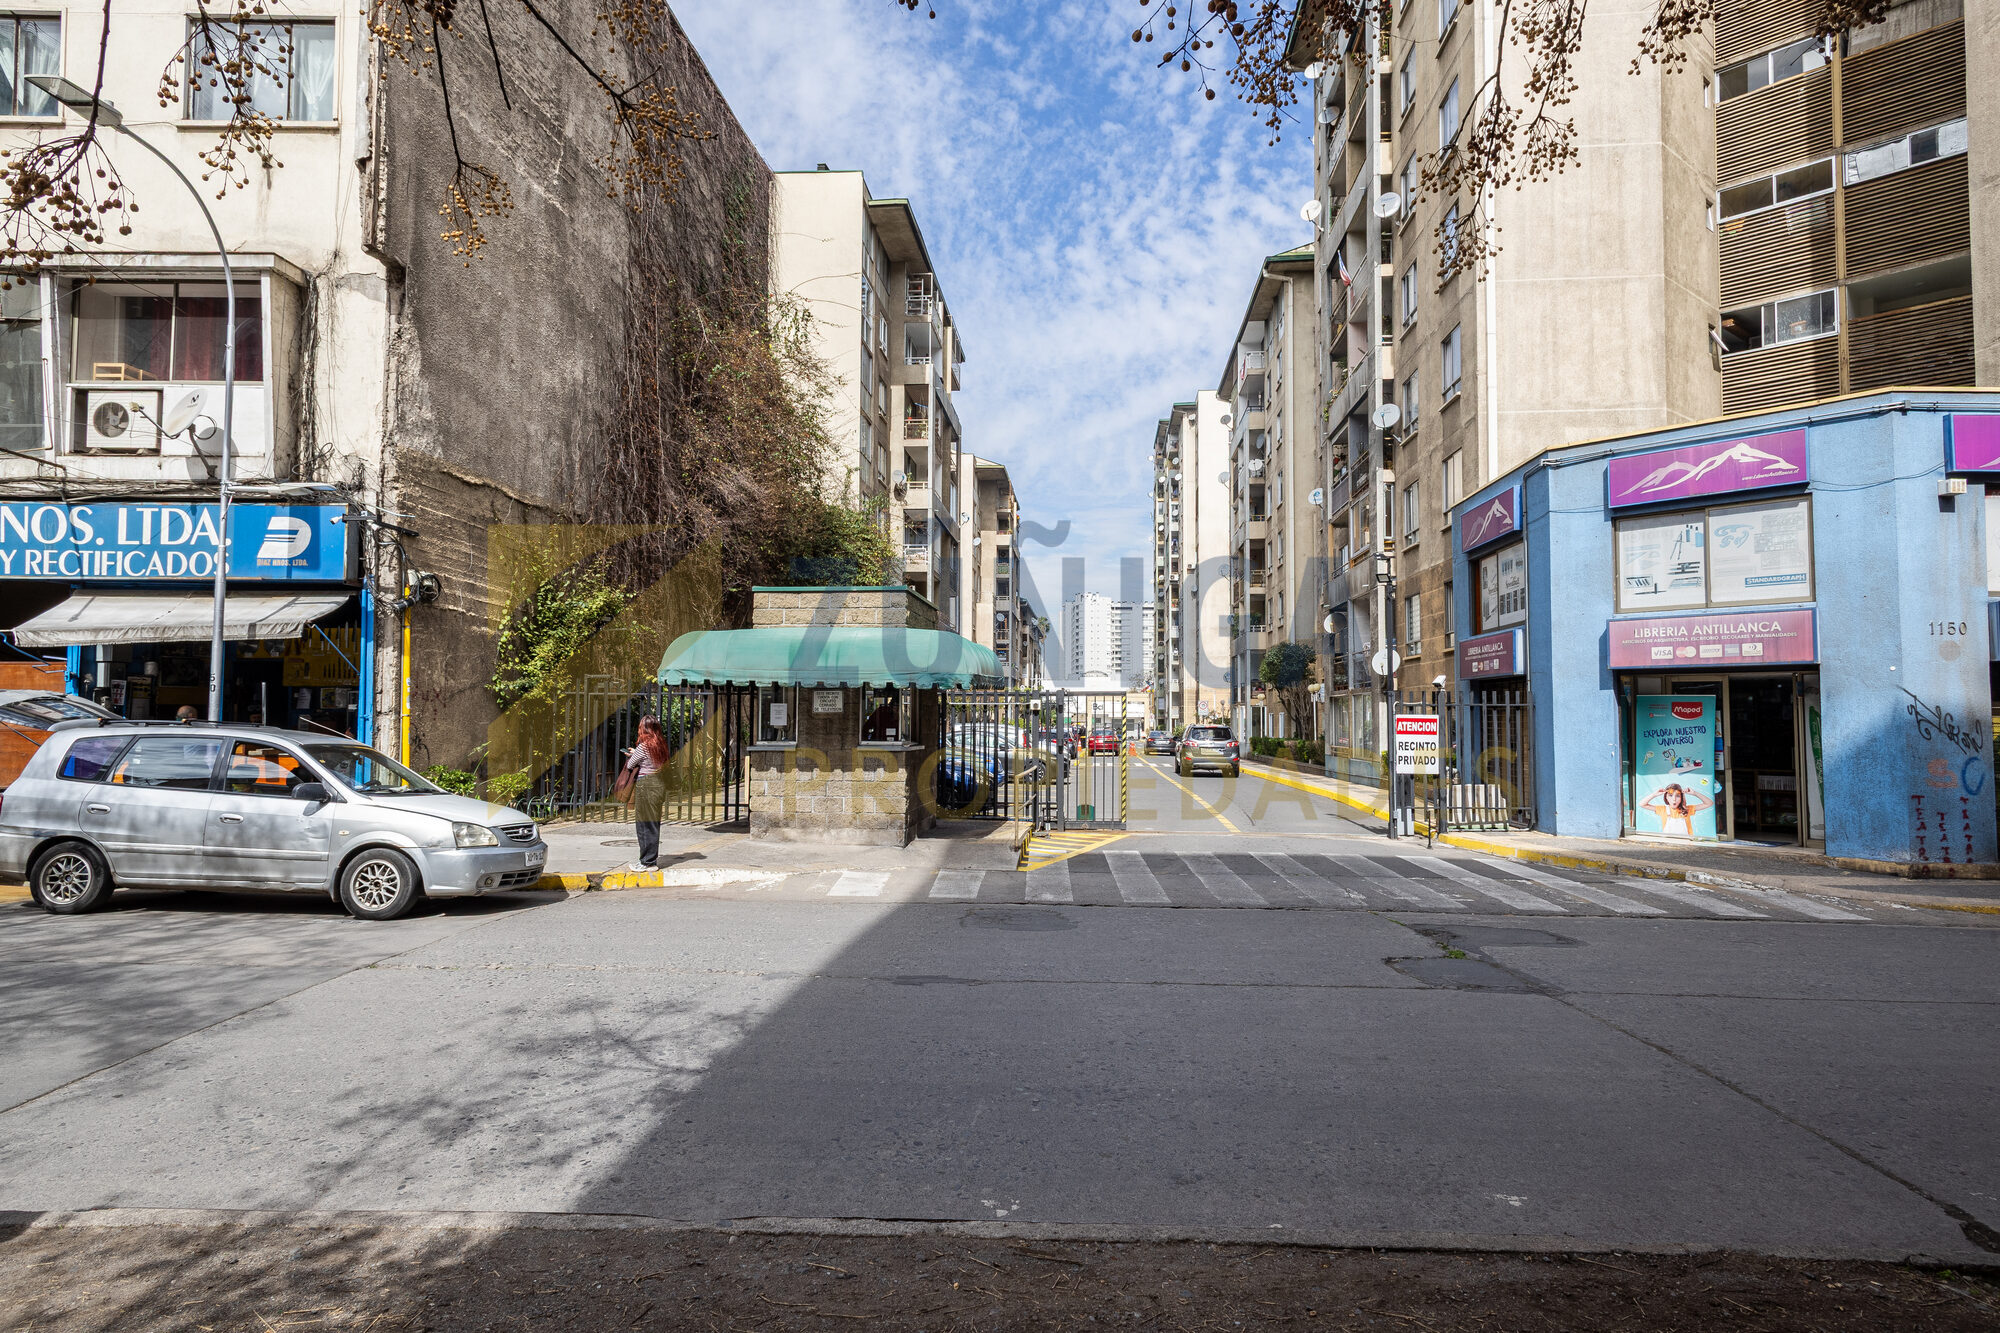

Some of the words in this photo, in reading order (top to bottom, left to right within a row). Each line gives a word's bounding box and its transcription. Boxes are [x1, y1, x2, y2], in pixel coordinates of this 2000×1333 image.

[117, 507, 232, 546] LTDA.
[0, 549, 18, 575] Y
[24, 549, 230, 577] RECTIFICADOS
[1634, 625, 1688, 638] LIBRERIA
[1692, 621, 1782, 636] ANTILLANCA
[1929, 621, 1968, 635] 1150
[1653, 649, 1672, 657] VISA
[1673, 706, 1702, 714] Maped
[1397, 721, 1437, 732] ATENCION
[1643, 728, 1673, 739] EXPLORA
[1675, 725, 1707, 736] NUESTRO
[1398, 741, 1437, 751] RECINTO
[1657, 736, 1694, 747] UNIVERSO
[1398, 755, 1436, 765] PRIVADO
